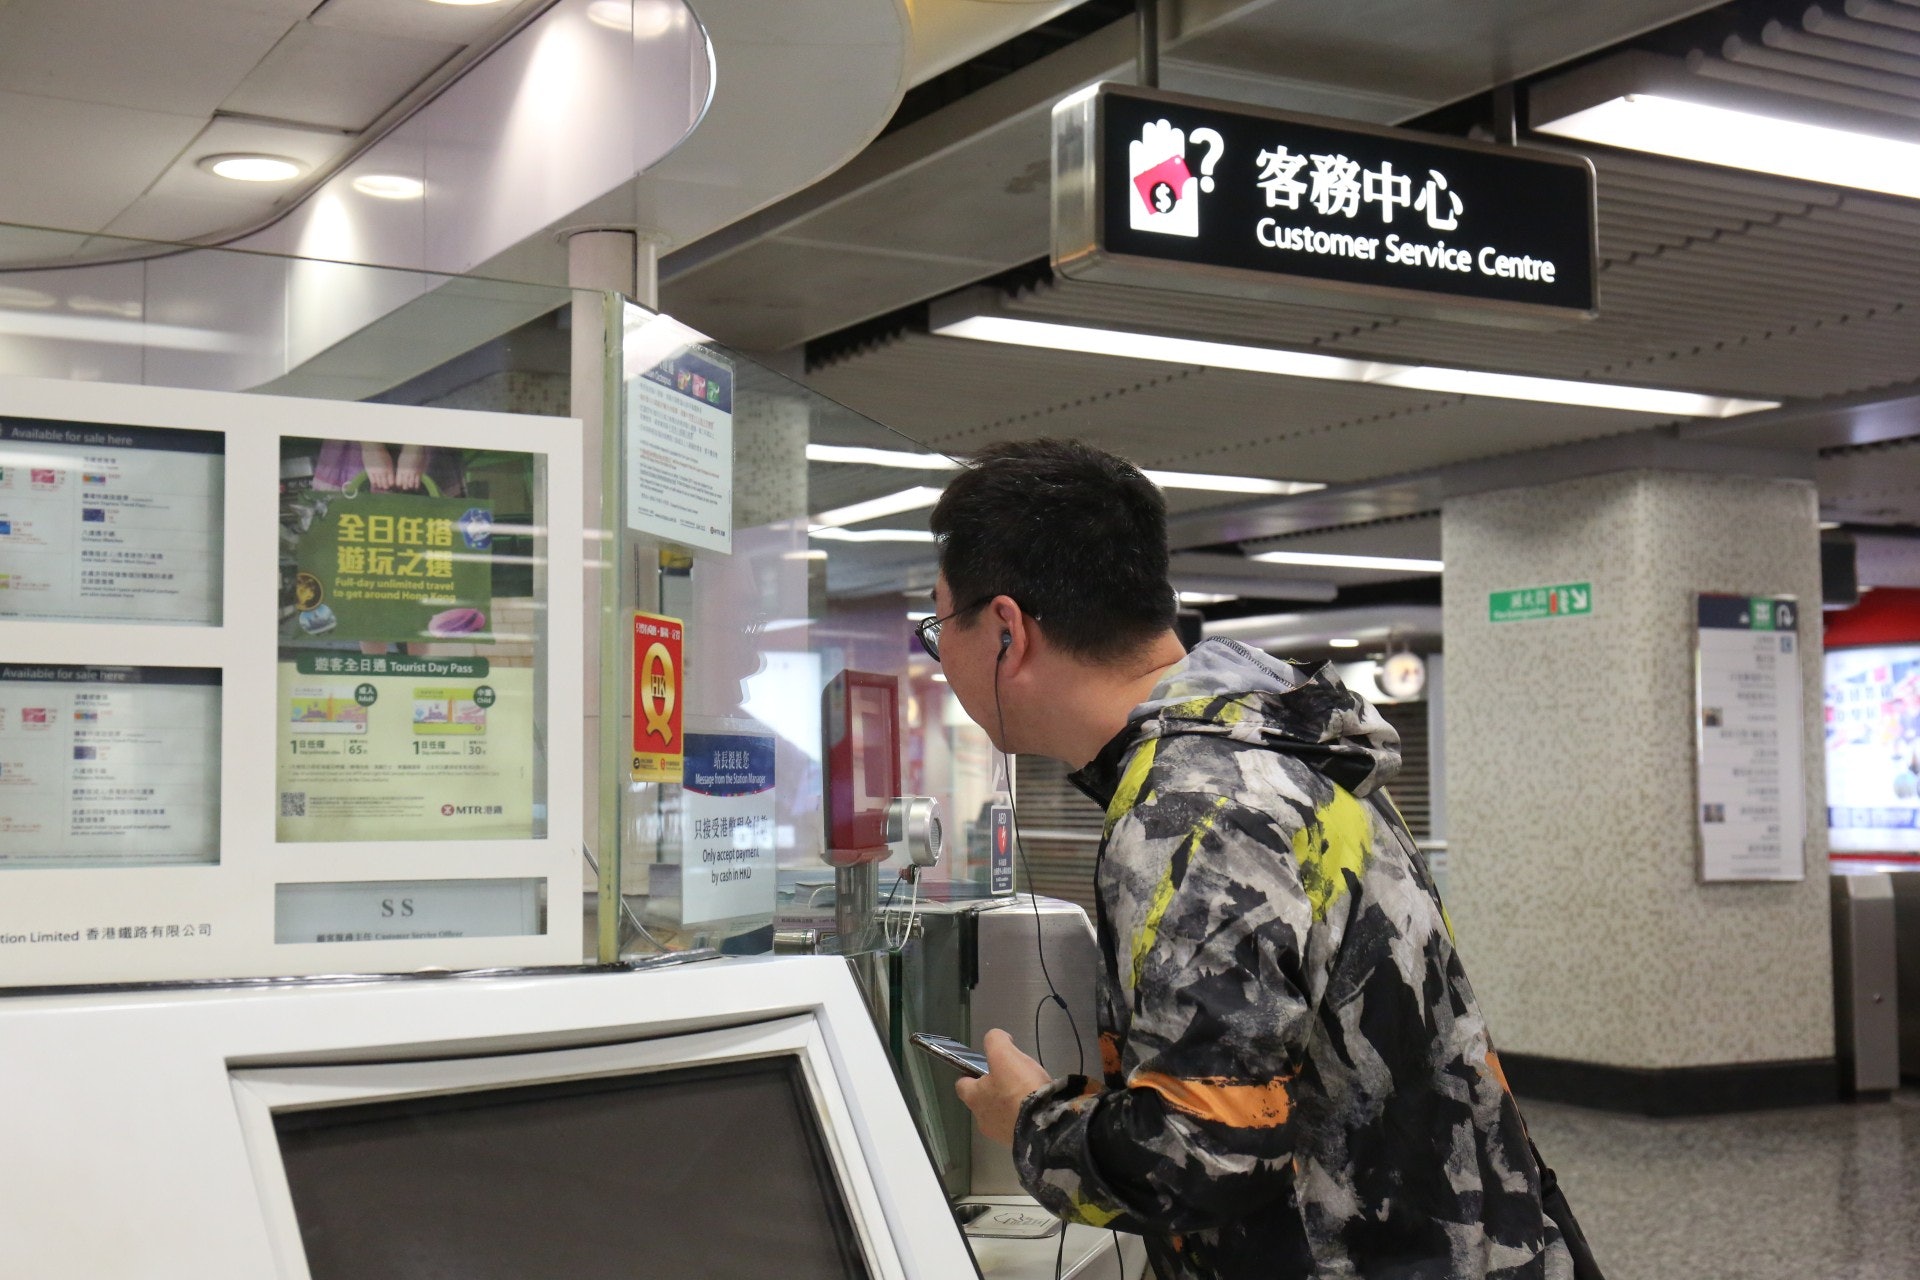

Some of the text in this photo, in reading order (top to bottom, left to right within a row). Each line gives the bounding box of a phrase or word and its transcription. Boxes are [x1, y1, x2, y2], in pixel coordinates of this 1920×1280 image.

[1255, 146, 1464, 231] 客務中心
[1256, 216, 1556, 283] Customer Service Centre
[11, 427, 133, 445] Available for sale here
[337, 513, 453, 547] 全日任搭
[337, 545, 453, 578] 遊玩之選
[335, 577, 454, 591] Full-day unlimited travel
[333, 589, 456, 604] to get around Hong Kong
[315, 657, 473, 675] 遊客全日通 Tourist Day Pass
[2, 668, 126, 682] Available for sale here
[650, 674, 666, 698] HK
[290, 740, 297, 755] 1
[349, 745, 362, 755] 65
[412, 741, 419, 755] 1
[469, 746, 482, 755] 30
[713, 750, 750, 770] 站長提提您
[695, 773, 714, 788] Message
[714, 772, 725, 785] from
[733, 772, 748, 785] Station
[748, 772, 766, 787] Manager
[456, 805, 482, 815] MTR
[998, 812, 1007, 825] AED
[703, 846, 760, 865] Only accept payment
[711, 866, 752, 886] by cash in HKD
[30, 930, 80, 943] Limited
[86, 923, 212, 941] 香港鐵路有限公司
[375, 931, 410, 940] Customer
[412, 931, 437, 939] Service
[438, 929, 464, 938] Officer
